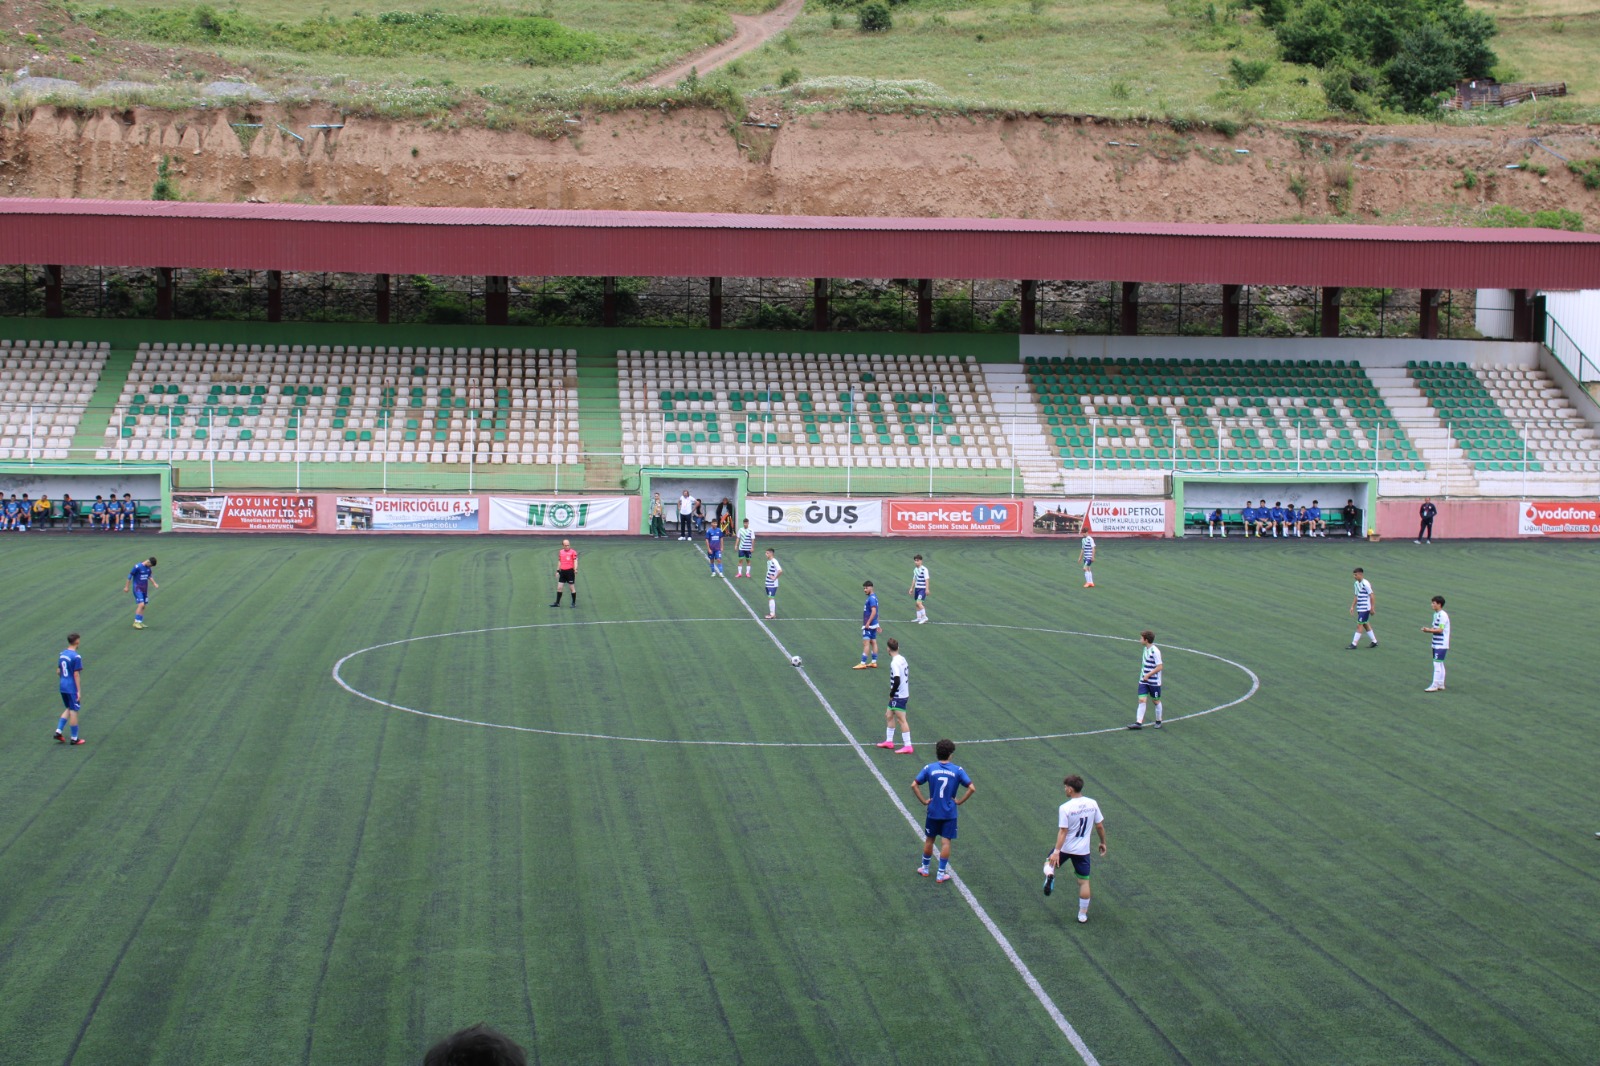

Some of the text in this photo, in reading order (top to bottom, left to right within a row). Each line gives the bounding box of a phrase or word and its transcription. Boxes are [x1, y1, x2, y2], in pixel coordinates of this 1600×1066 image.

[227, 498, 314, 507] KOYUNCULAR
[375, 498, 449, 513] DEMİRCİOĞLU
[452, 501, 474, 516] A.Ş.
[227, 507, 314, 519] AKARYAKIT LTD. ŞTİ.
[1538, 507, 1597, 520] vodafone
[1140, 517, 1165, 525] BAŞKANI
[61, 660, 69, 678] 8
[937, 777, 948, 798] 7
[1075, 817, 1088, 838] 11
